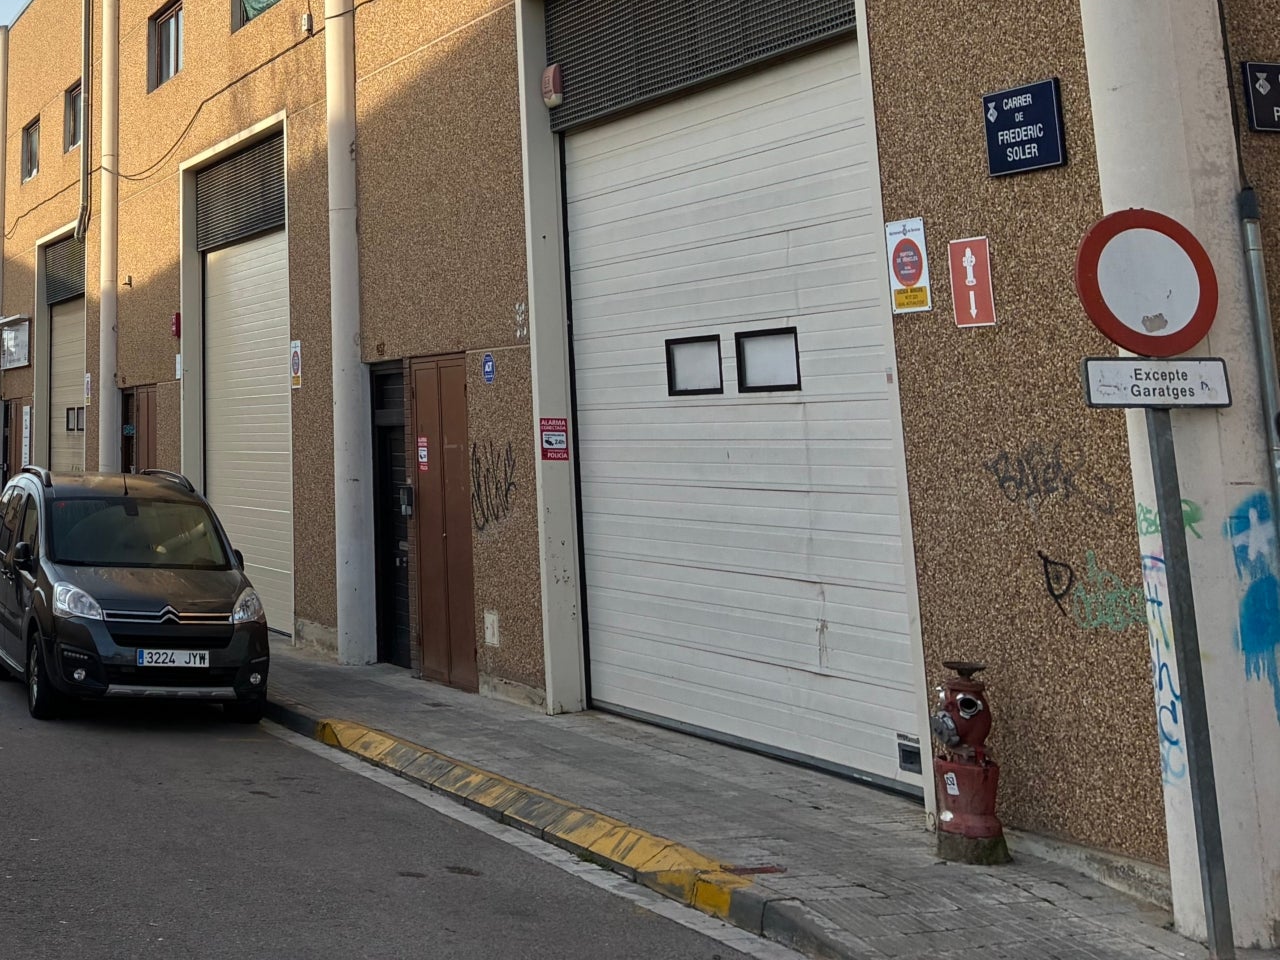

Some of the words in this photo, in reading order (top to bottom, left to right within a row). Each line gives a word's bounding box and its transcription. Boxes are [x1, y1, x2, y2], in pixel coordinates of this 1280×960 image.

[1002, 93, 1032, 110] CARRER
[1014, 112, 1024, 122] DE
[998, 123, 1044, 145] FREDERIC
[1006, 143, 1039, 161] SOLER
[1133, 368, 1188, 383] Excepte
[1130, 384, 1195, 399] Garatges
[146, 651, 176, 664] 3224
[184, 652, 206, 665] JYW
